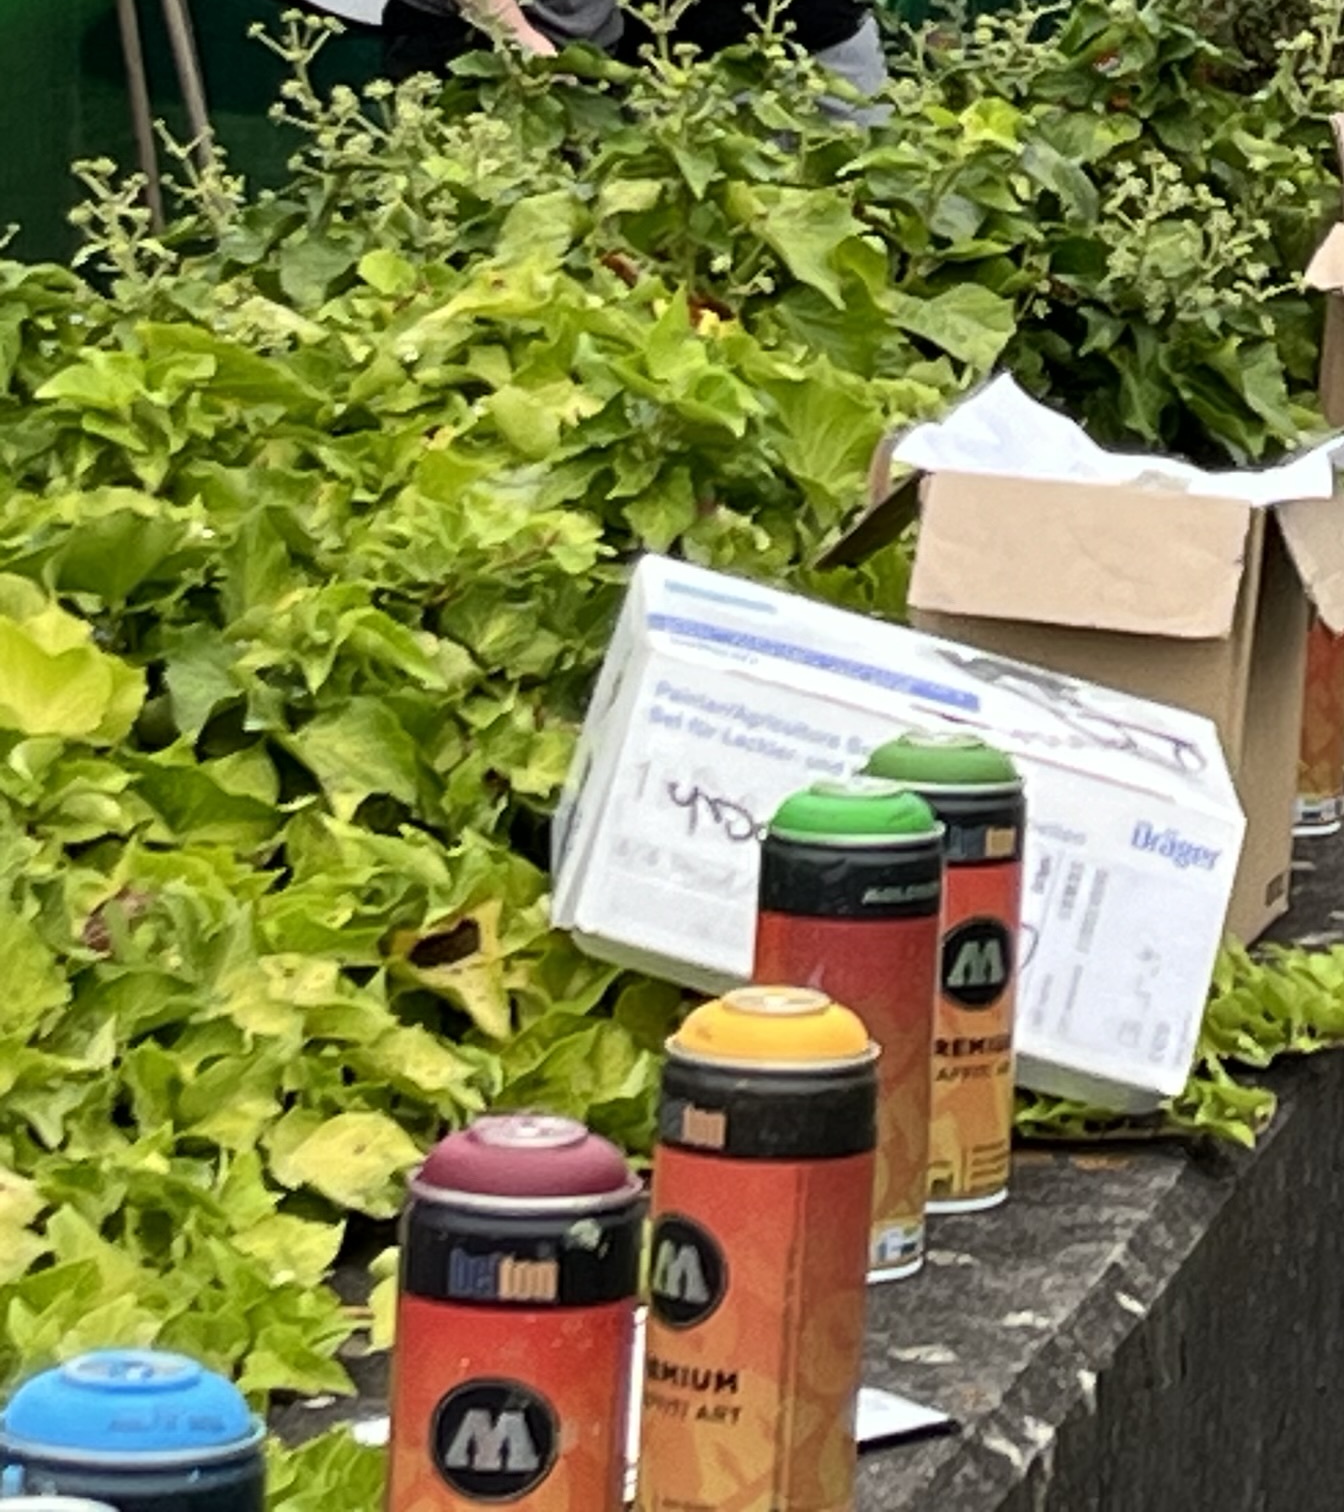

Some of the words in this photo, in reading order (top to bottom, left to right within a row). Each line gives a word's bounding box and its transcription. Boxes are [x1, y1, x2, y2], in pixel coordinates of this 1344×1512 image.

[1131, 819, 1223, 872] Dräger
[946, 940, 1004, 987] M
[653, 1239, 709, 1304] M
[444, 1408, 540, 1472] M
